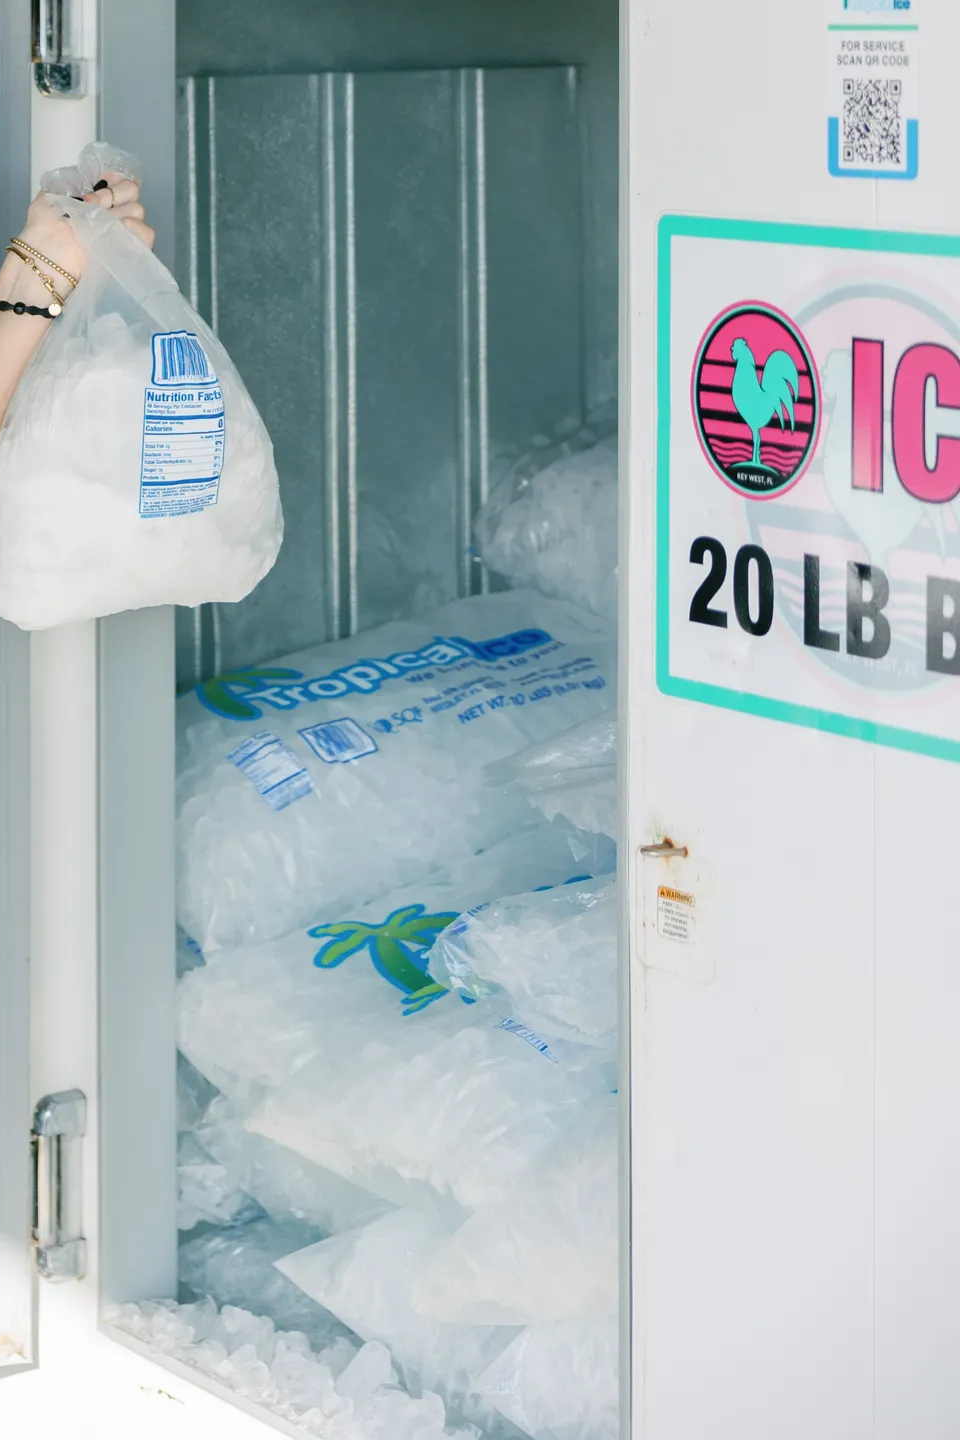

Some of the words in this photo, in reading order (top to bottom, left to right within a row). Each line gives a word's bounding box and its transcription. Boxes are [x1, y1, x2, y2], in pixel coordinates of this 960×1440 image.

[840, 40, 861, 52] FOR
[863, 40, 905, 52] SERVICE
[836, 54, 863, 67] SCAN
[865, 54, 880, 66] QR
[882, 54, 910, 67] CODE
[147, 391, 194, 402] Nutrition
[197, 390, 222, 401] Facts
[736, 471, 748, 481] KEY
[688, 535, 775, 638] 20
[803, 552, 891, 660] LB
[243, 636, 474, 706] Tropical
[457, 704, 486, 725] NET
[665, 890, 692, 903] WARNING
